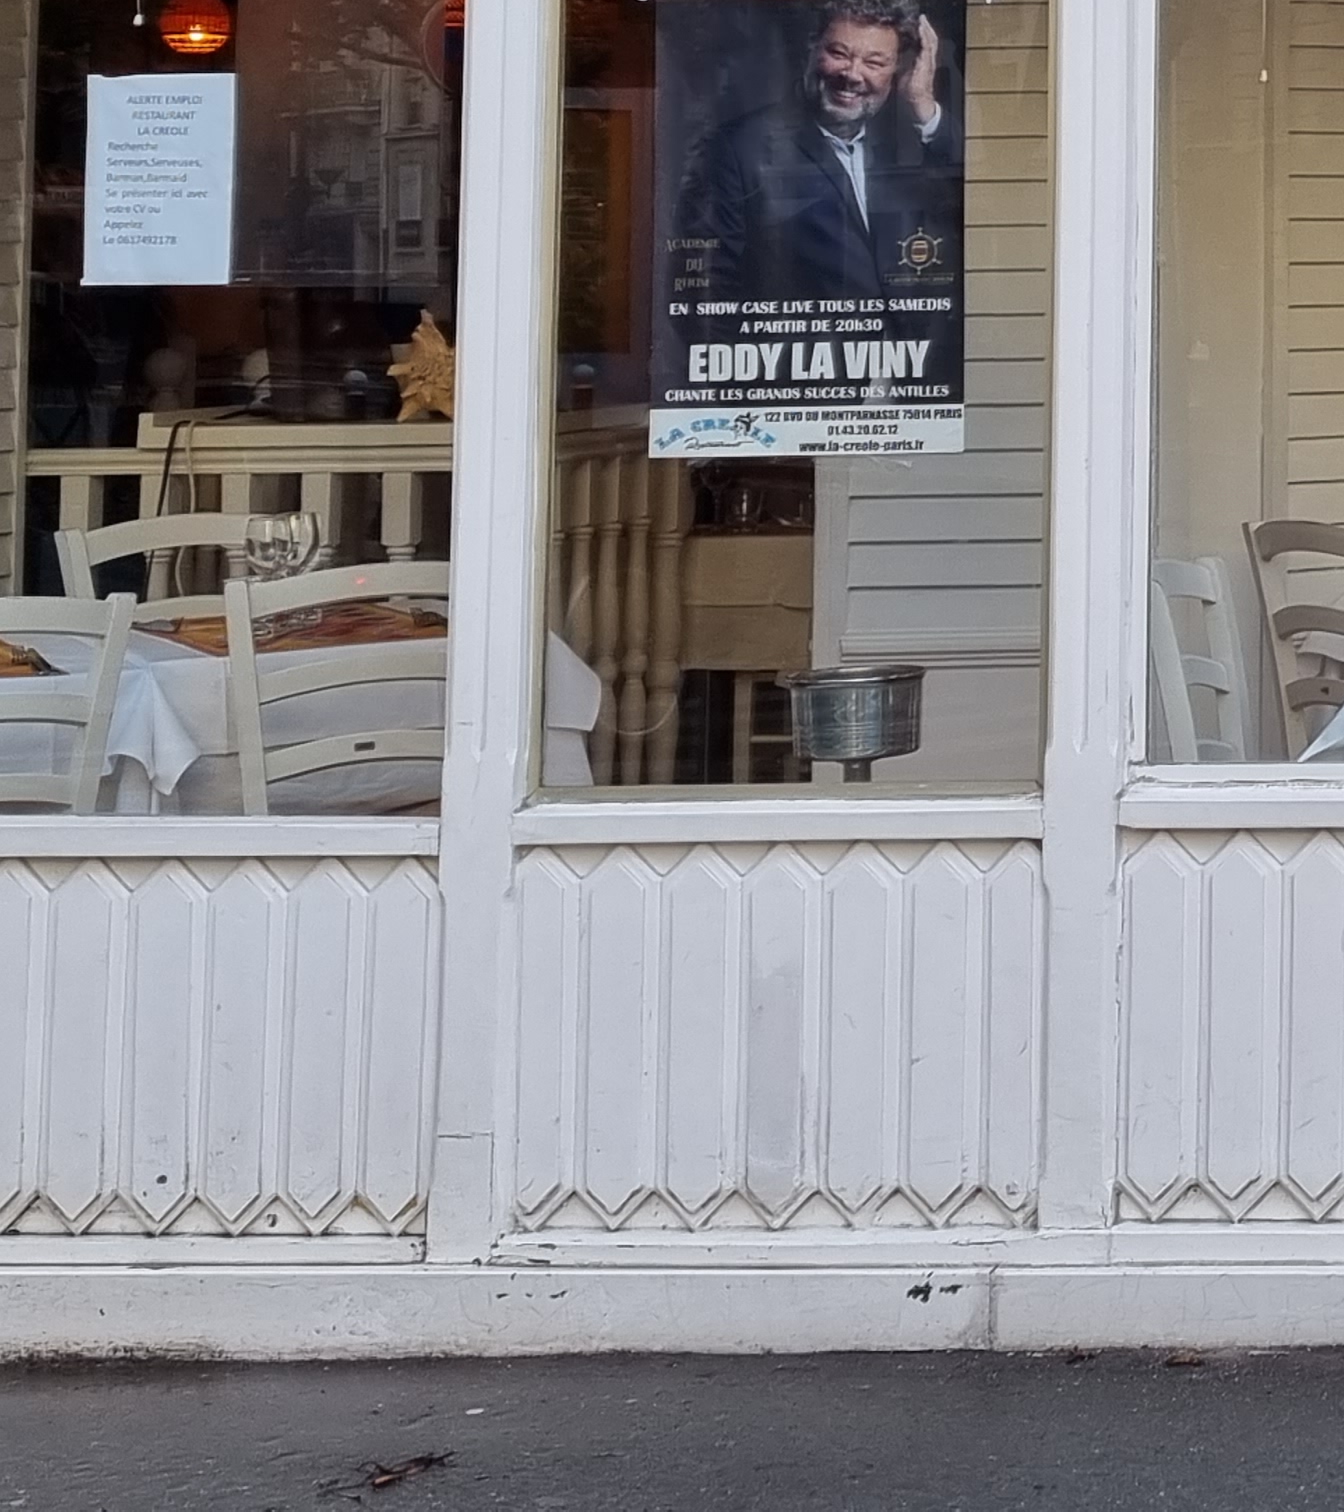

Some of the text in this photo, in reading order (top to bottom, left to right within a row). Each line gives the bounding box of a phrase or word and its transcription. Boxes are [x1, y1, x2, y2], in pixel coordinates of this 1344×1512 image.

[127, 95, 203, 105] ALERTE EMPLOI
[132, 111, 196, 120] RESTAURANT
[137, 126, 189, 136] LA CREOLE
[107, 141, 158, 151] Recherche
[105, 188, 208, 199] Se présenter ici avec
[104, 204, 161, 214] votre CV ou
[104, 220, 143, 230] Appelez
[103, 235, 114, 244] Le
[669, 298, 952, 315] EN SHOW CASE LIVE TOUS LES SAMEDIS
[740, 319, 883, 334] A PARTIR DE 20h30
[689, 340, 931, 383] EDDY LA VINY
[665, 385, 949, 402] CHANTE LES GRANDS SUCCES DES ANTILLES
[764, 412, 781, 422] 122
[933, 408, 962, 419] PARIS
[690, 412, 777, 448] CRELE
